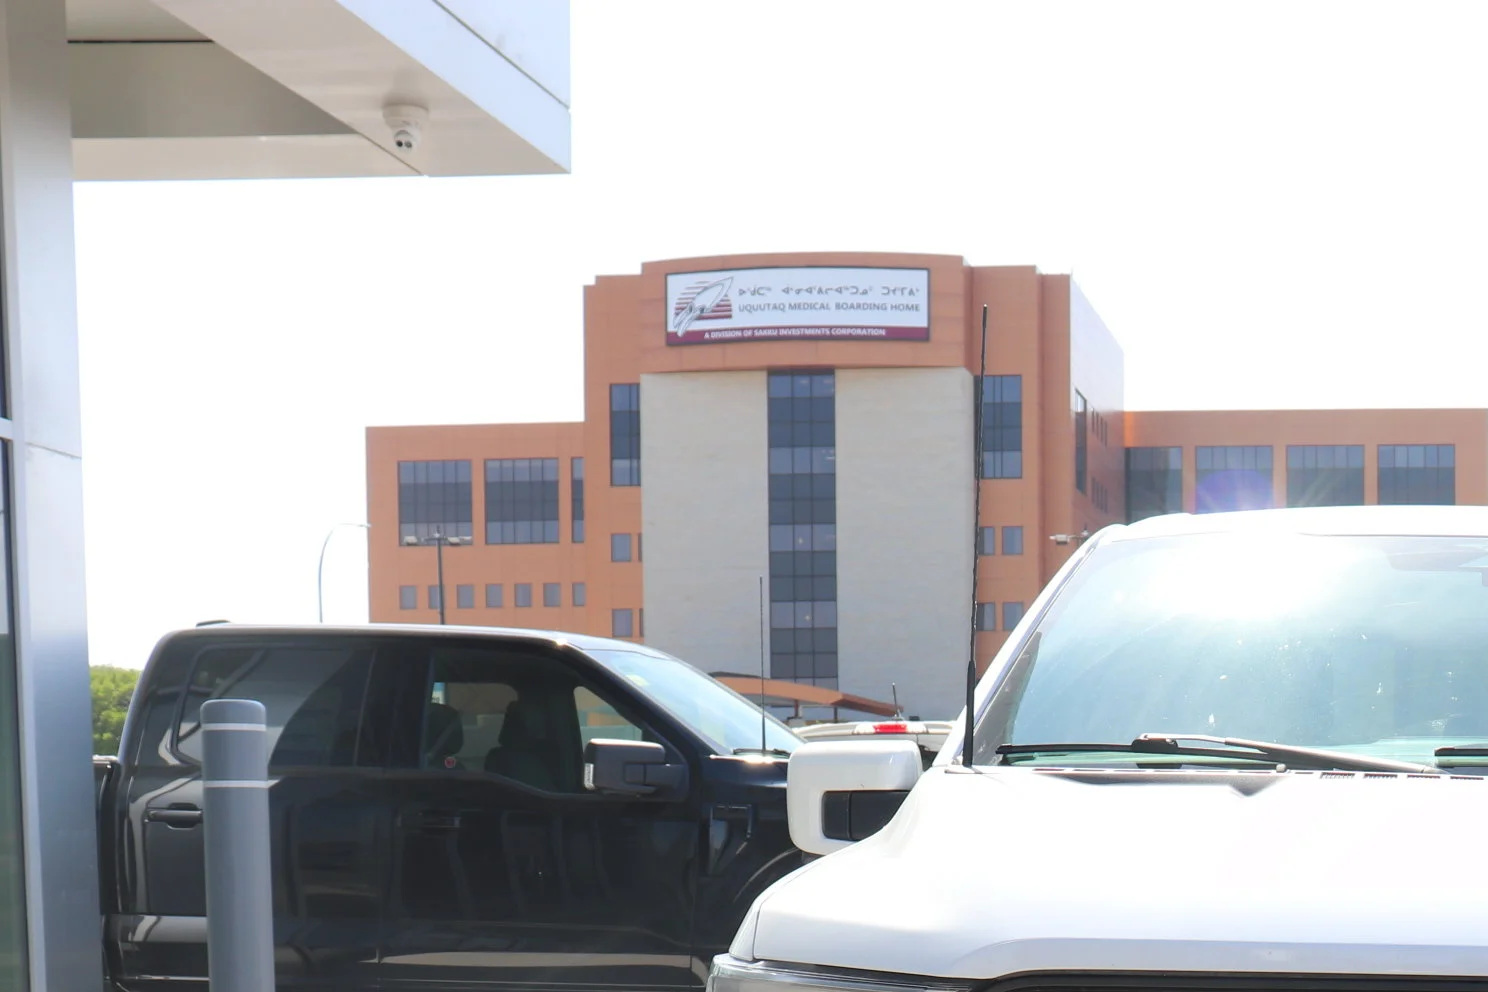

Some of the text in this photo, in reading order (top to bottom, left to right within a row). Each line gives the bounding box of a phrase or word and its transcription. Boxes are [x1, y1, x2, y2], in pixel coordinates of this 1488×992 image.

[738, 302, 920, 313] UQUUTAQ MEDICAL BOARDING HOME
[710, 330, 742, 338] DIVISION
[743, 329, 753, 337] OF
[779, 327, 830, 336] INVESTMENTS
[831, 327, 886, 336] CORPORATION
